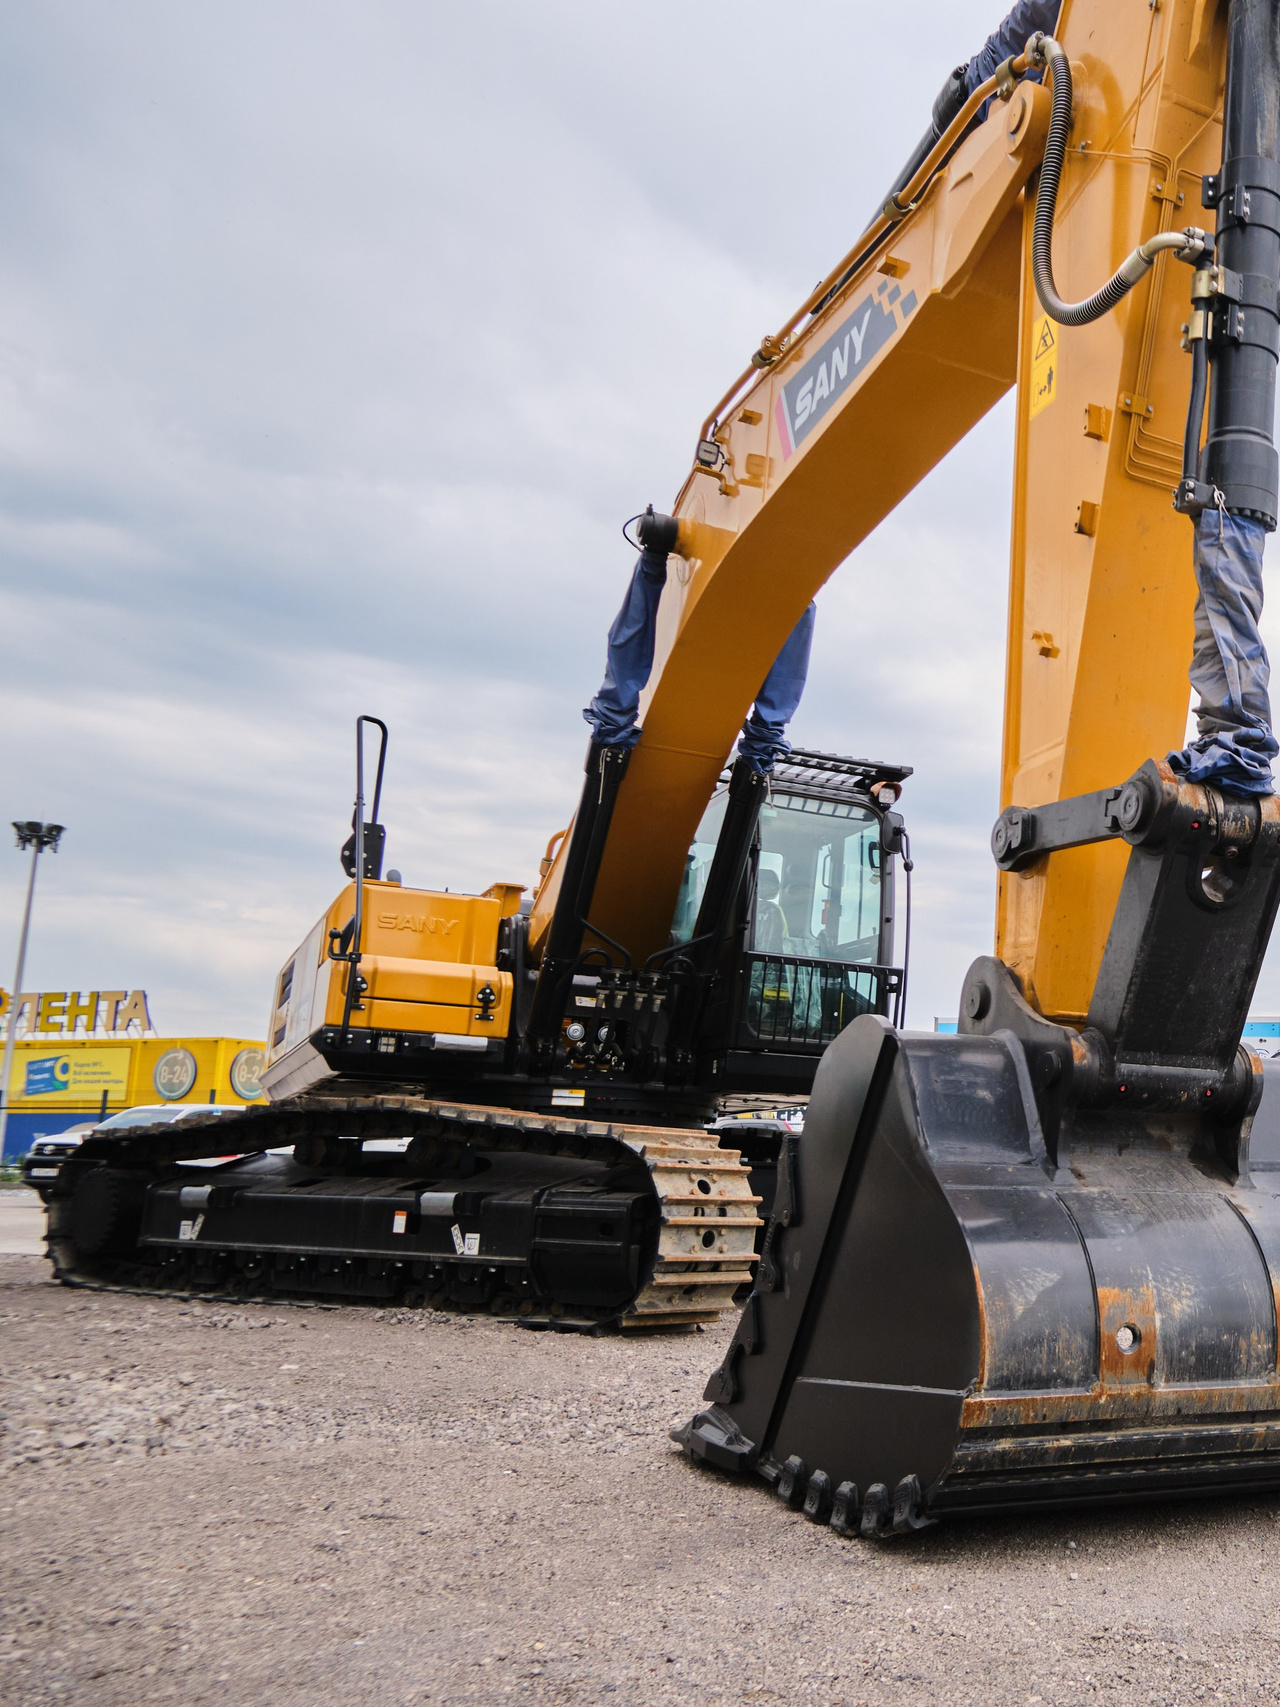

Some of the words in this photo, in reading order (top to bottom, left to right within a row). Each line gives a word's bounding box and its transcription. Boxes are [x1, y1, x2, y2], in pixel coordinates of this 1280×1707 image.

[793, 307, 872, 431] SANY
[378, 912, 459, 935] SANY
[161, 1066, 187, 1083] 8-24
